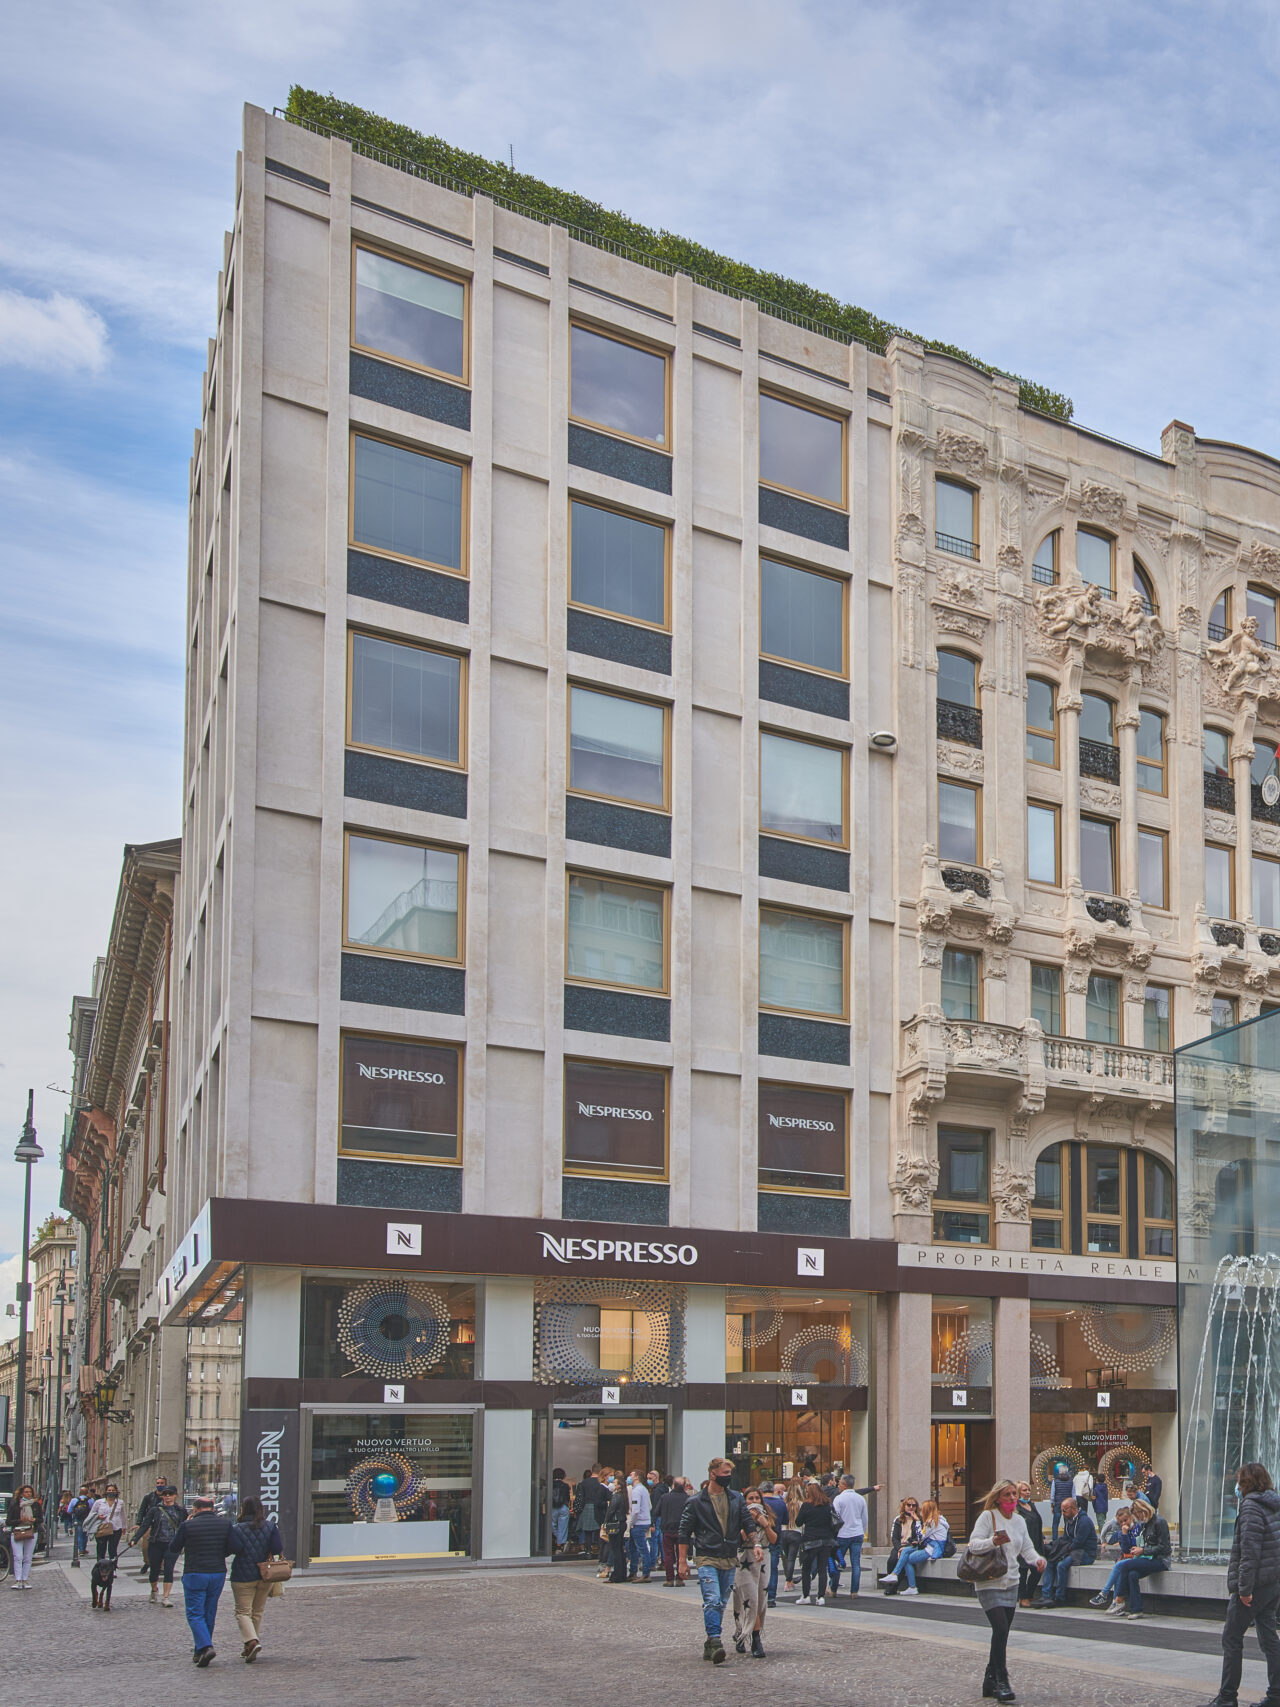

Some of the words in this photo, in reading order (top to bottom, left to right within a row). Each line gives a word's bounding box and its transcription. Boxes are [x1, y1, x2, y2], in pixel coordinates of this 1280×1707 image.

[356, 1062, 444, 1085] NESPRESSO
[577, 1101, 653, 1121] NESPRESSO
[768, 1113, 835, 1132] NESPRESSO
[536, 1231, 698, 1266] NESPRESSO
[917, 1251, 1063, 1272] PROPRIETA
[1091, 1262, 1163, 1279] REALE
[356, 1438, 392, 1446] NUOVO
[394, 1438, 432, 1446] VERTUO
[257, 1424, 285, 1529] NESPRES
